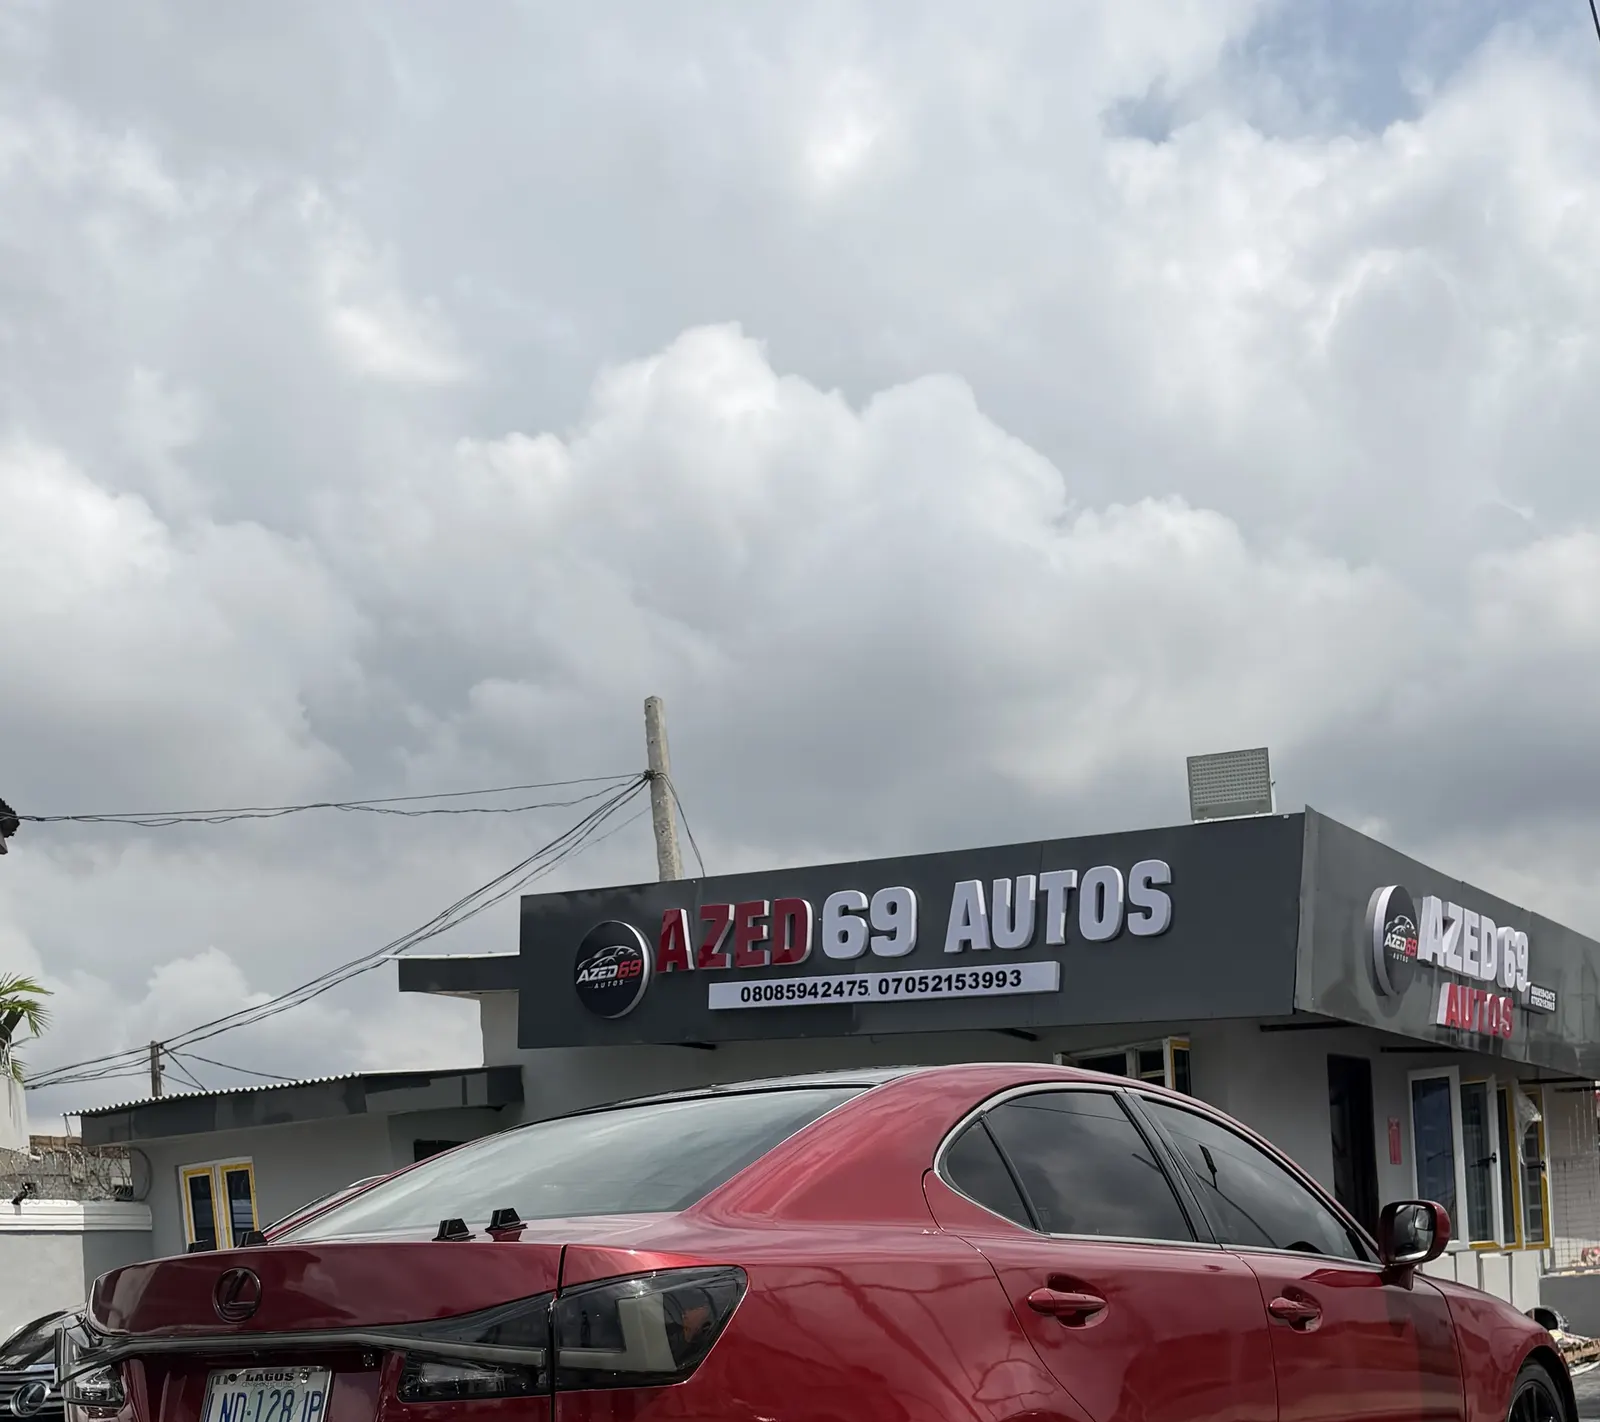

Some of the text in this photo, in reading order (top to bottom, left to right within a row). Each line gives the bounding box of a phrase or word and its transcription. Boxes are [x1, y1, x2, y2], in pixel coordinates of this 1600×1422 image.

[944, 859, 1173, 954] AUTOS
[576, 959, 643, 985] AZED69
[594, 979, 624, 989] AUTOS
[878, 969, 1022, 996] 07052153993
[1437, 982, 1514, 1039] AUTOS
[245, 1372, 295, 1382] LAGOS
